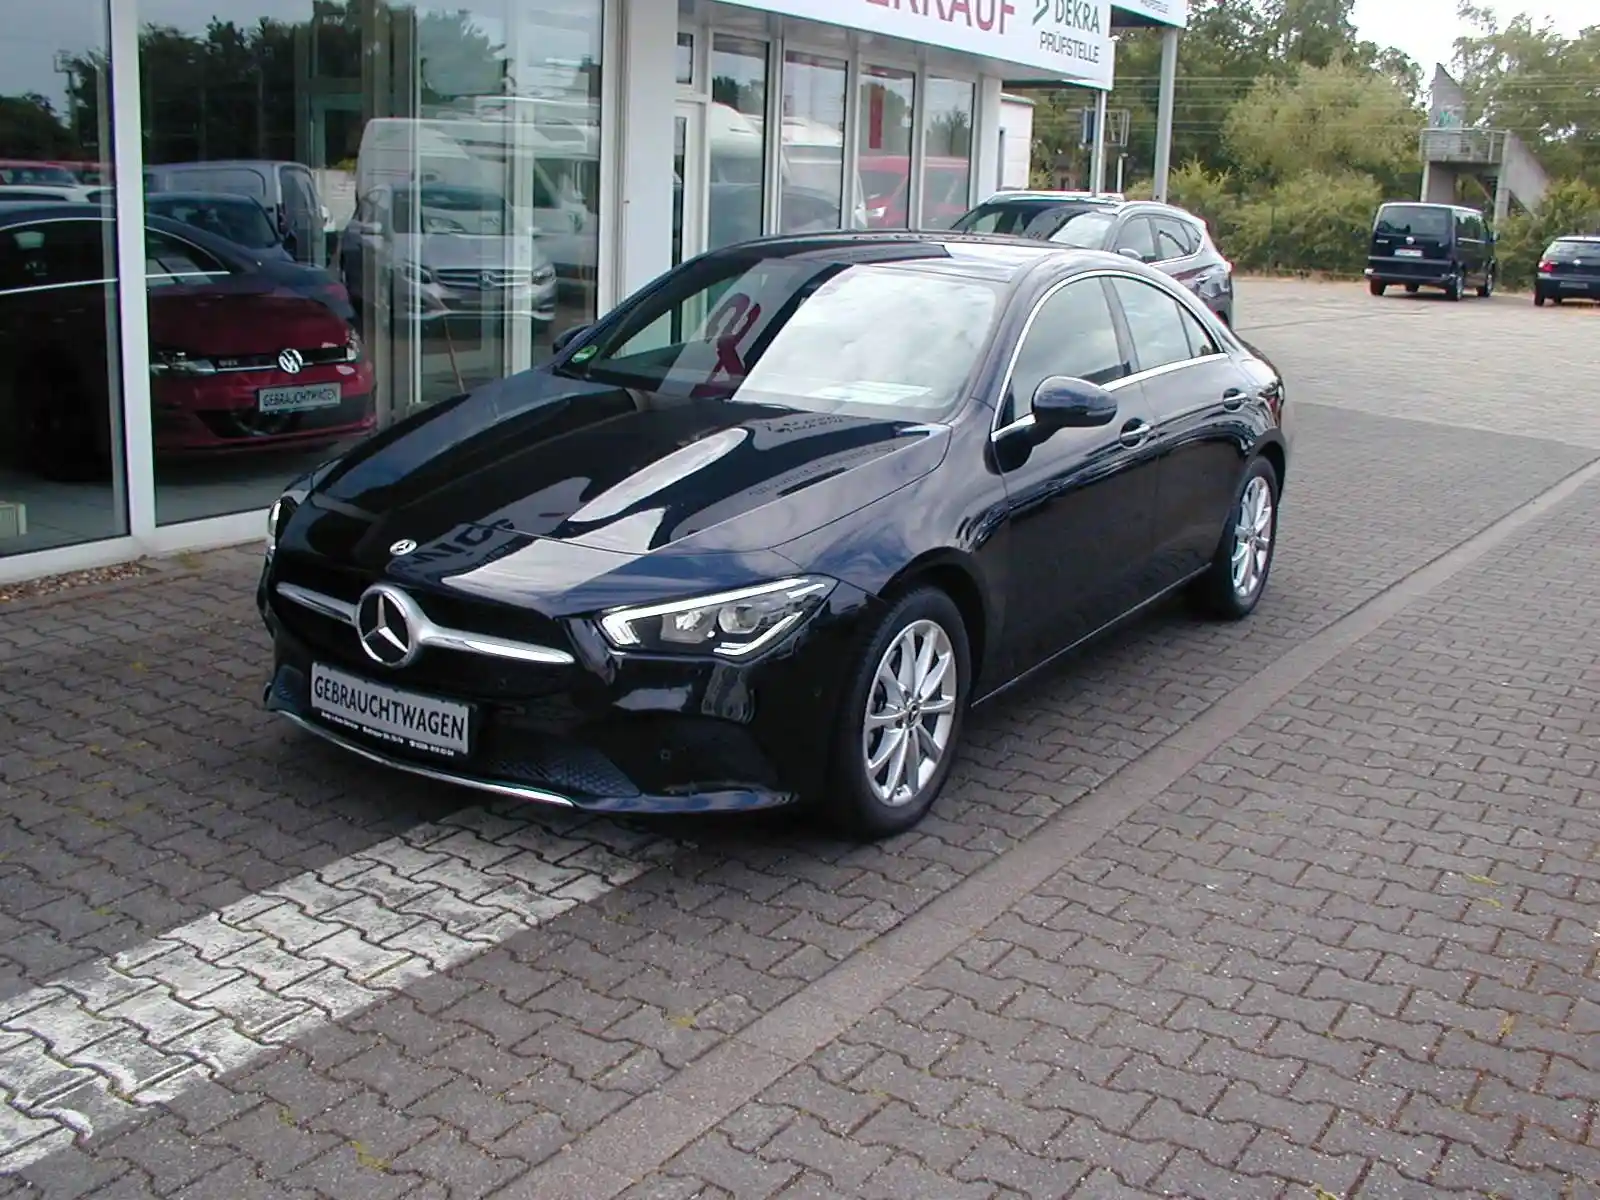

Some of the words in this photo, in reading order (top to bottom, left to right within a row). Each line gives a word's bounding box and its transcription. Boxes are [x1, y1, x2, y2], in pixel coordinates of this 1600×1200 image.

[1055, 0, 1099, 34] DEKRA
[1040, 31, 1099, 64] PRÜFSTELLE
[314, 676, 465, 741] GEBRAUCHTWAGEN
